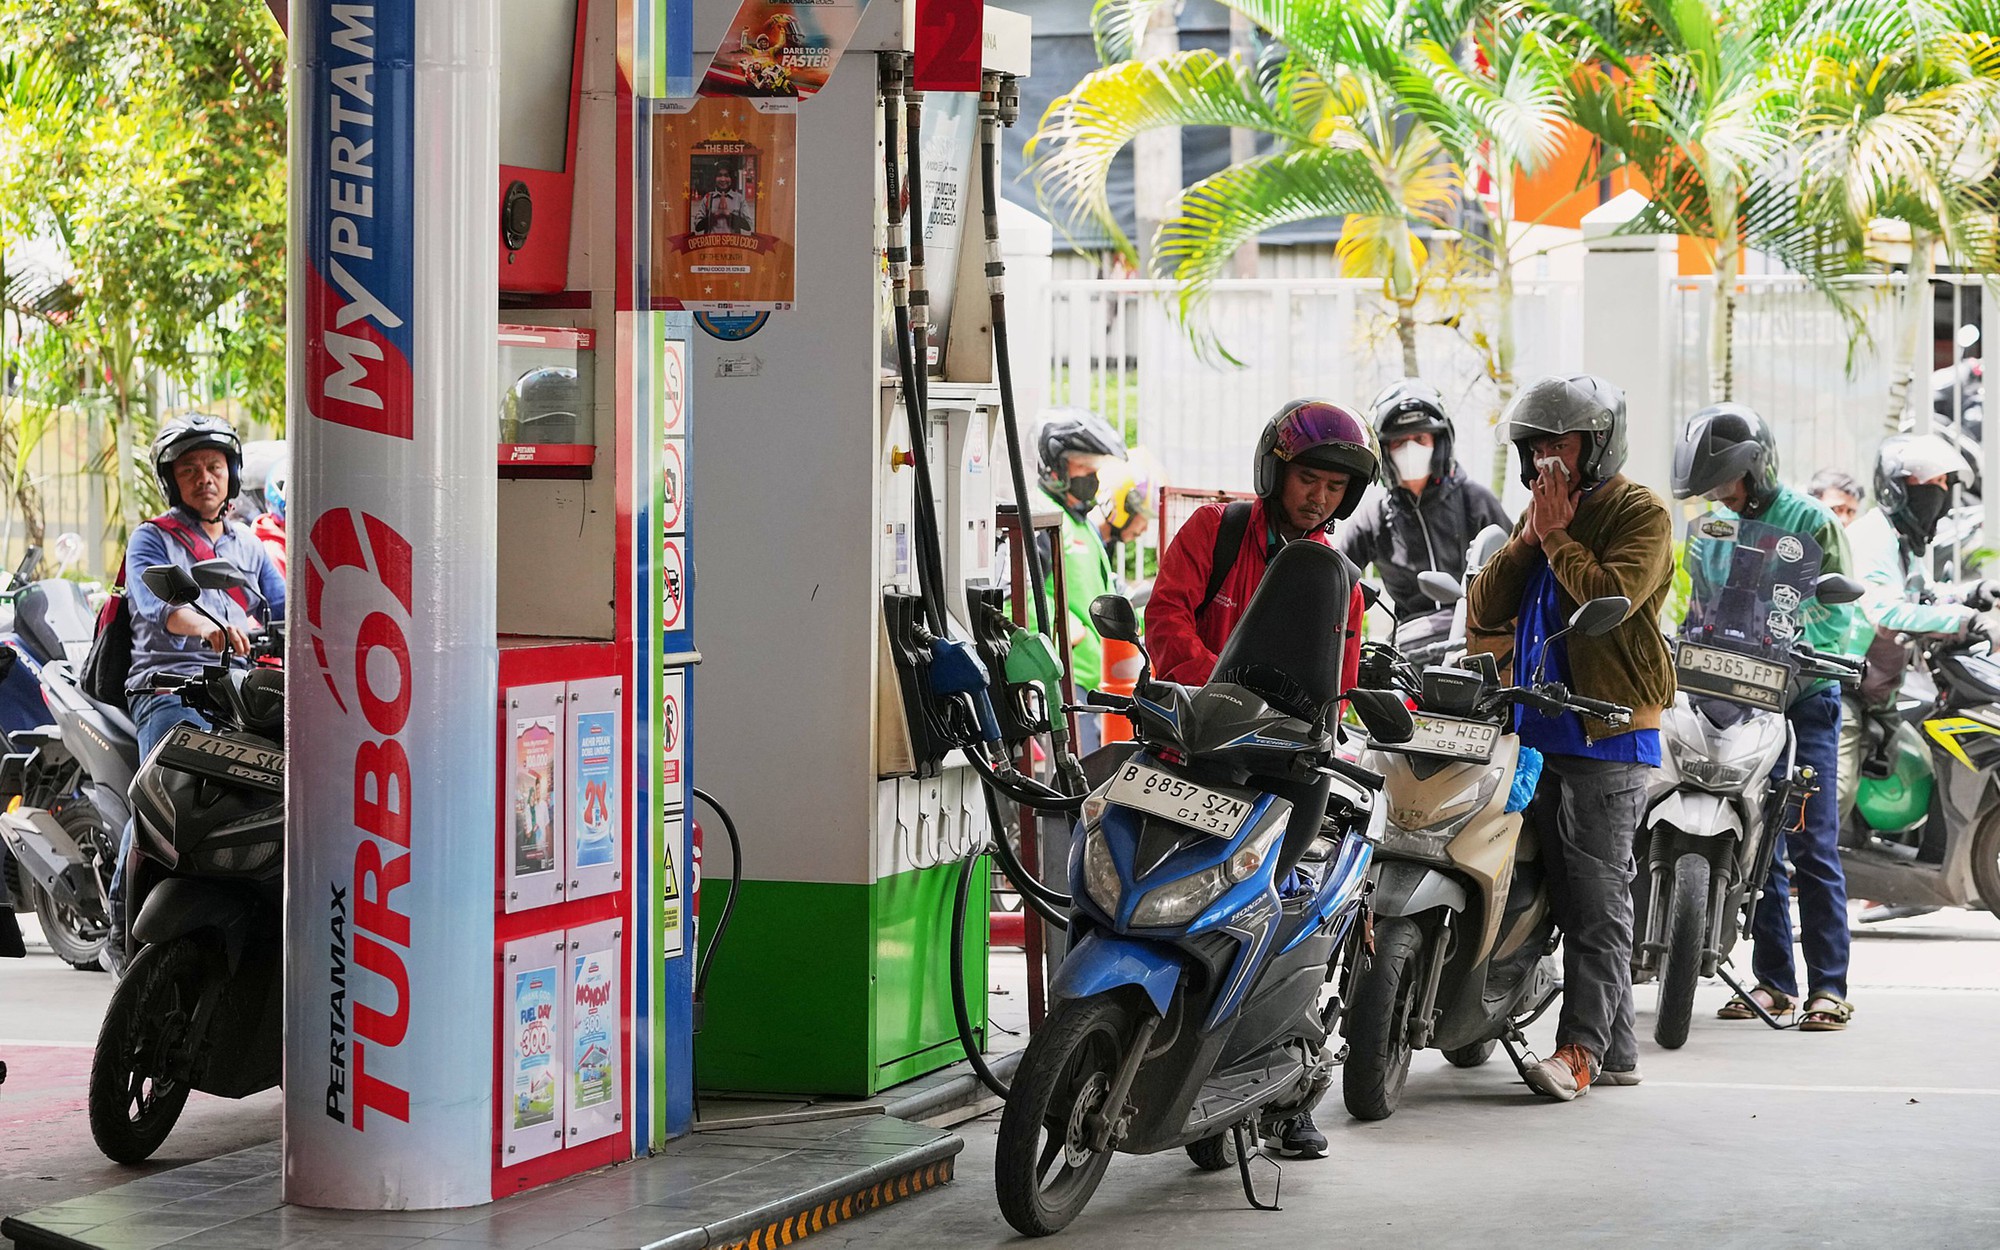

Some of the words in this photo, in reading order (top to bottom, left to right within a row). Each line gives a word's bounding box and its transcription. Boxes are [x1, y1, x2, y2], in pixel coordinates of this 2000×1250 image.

[919, 0, 979, 82] 2
[781, 55, 829, 67] FASTER
[704, 144, 721, 153] THE
[723, 144, 745, 153] BEST
[688, 235, 721, 249] OPERATOR
[740, 237, 759, 250] COCO
[1683, 649, 1694, 666] B
[1702, 654, 1744, 677] 5365
[1752, 665, 1783, 687] FPT
[257, 685, 285, 696] HONDA
[1208, 692, 1243, 706] HONDA
[179, 733, 191, 747] B
[1256, 739, 1293, 747] TECHNO
[1123, 765, 1139, 781] B
[1145, 773, 1199, 801] 6857
[1202, 794, 1244, 818] SZN
[351, 610, 413, 1132] TURBO
[1230, 892, 1268, 922] HONDA
[326, 881, 347, 1125] PERTAMAX
[575, 980, 611, 1008] MONDAY
[520, 1006, 536, 1025] FUEL
[538, 1003, 552, 1020] DAY
[522, 1025, 549, 1058] 300
